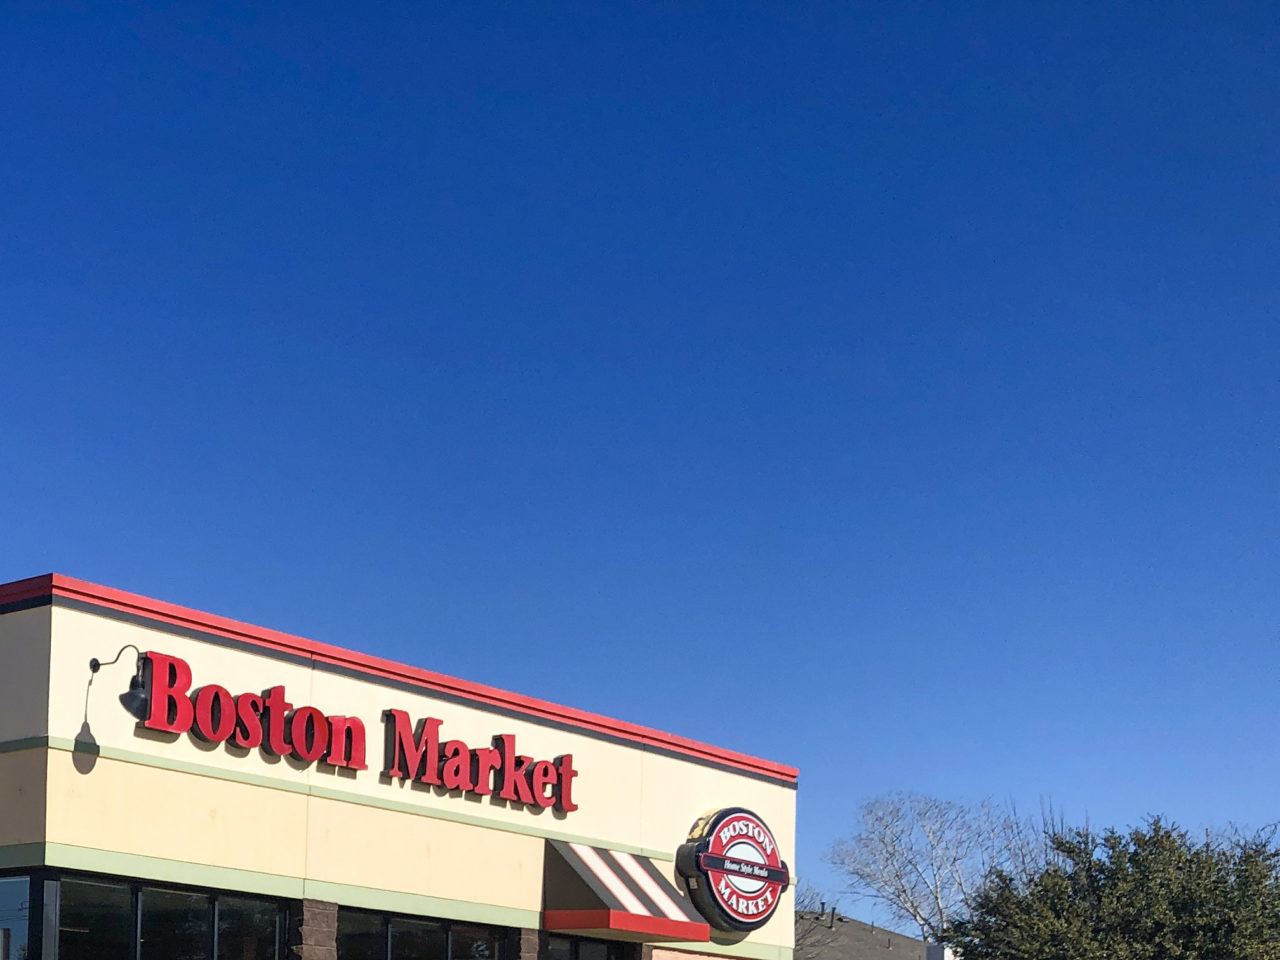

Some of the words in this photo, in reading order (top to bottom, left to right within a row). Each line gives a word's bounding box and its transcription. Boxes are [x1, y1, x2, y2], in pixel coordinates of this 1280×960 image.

[136, 650, 368, 771] Boston
[381, 708, 579, 813] Market
[719, 820, 774, 856] BOSTON
[717, 878, 774, 915] MARKET
